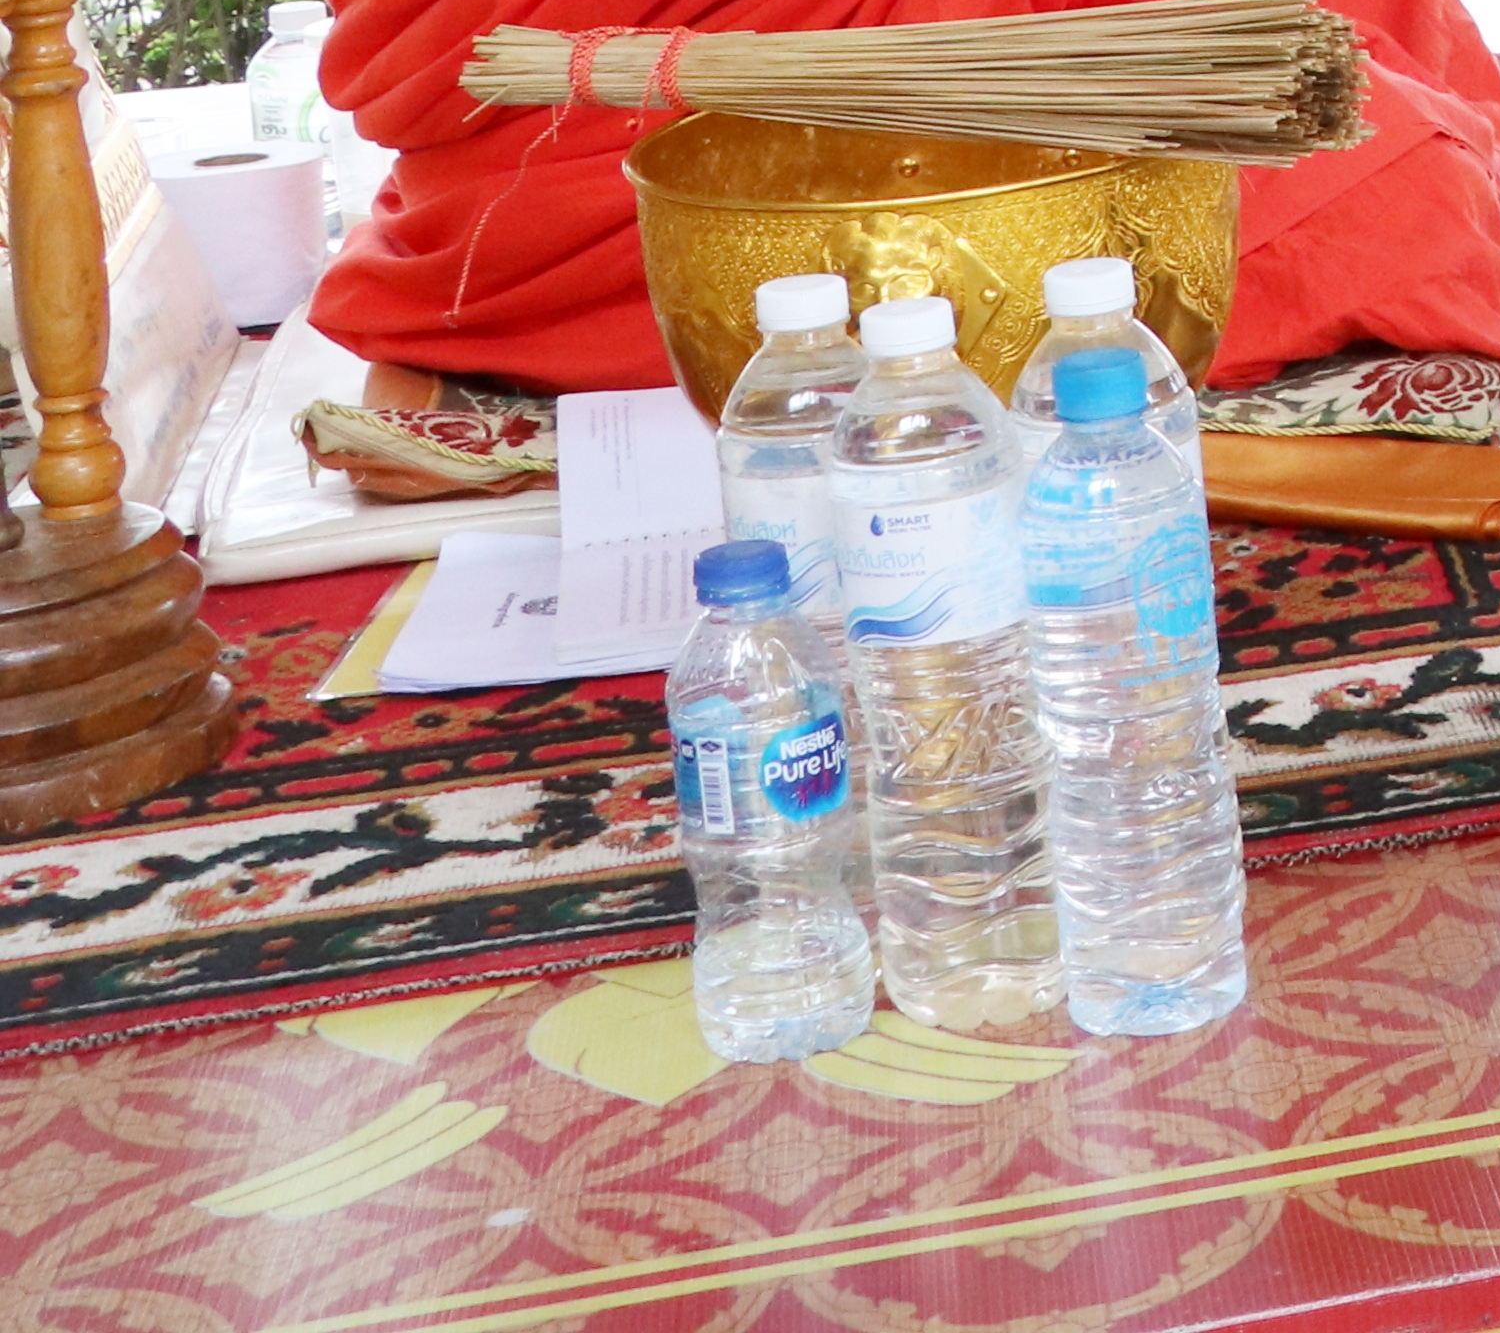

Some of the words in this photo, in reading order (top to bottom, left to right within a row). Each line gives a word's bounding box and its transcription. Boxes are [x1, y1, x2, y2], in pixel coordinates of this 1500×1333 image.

[886, 513, 930, 528] SMART
[779, 721, 838, 761] Nestlé
[763, 755, 822, 786] Pure
[823, 739, 847, 775] Life
